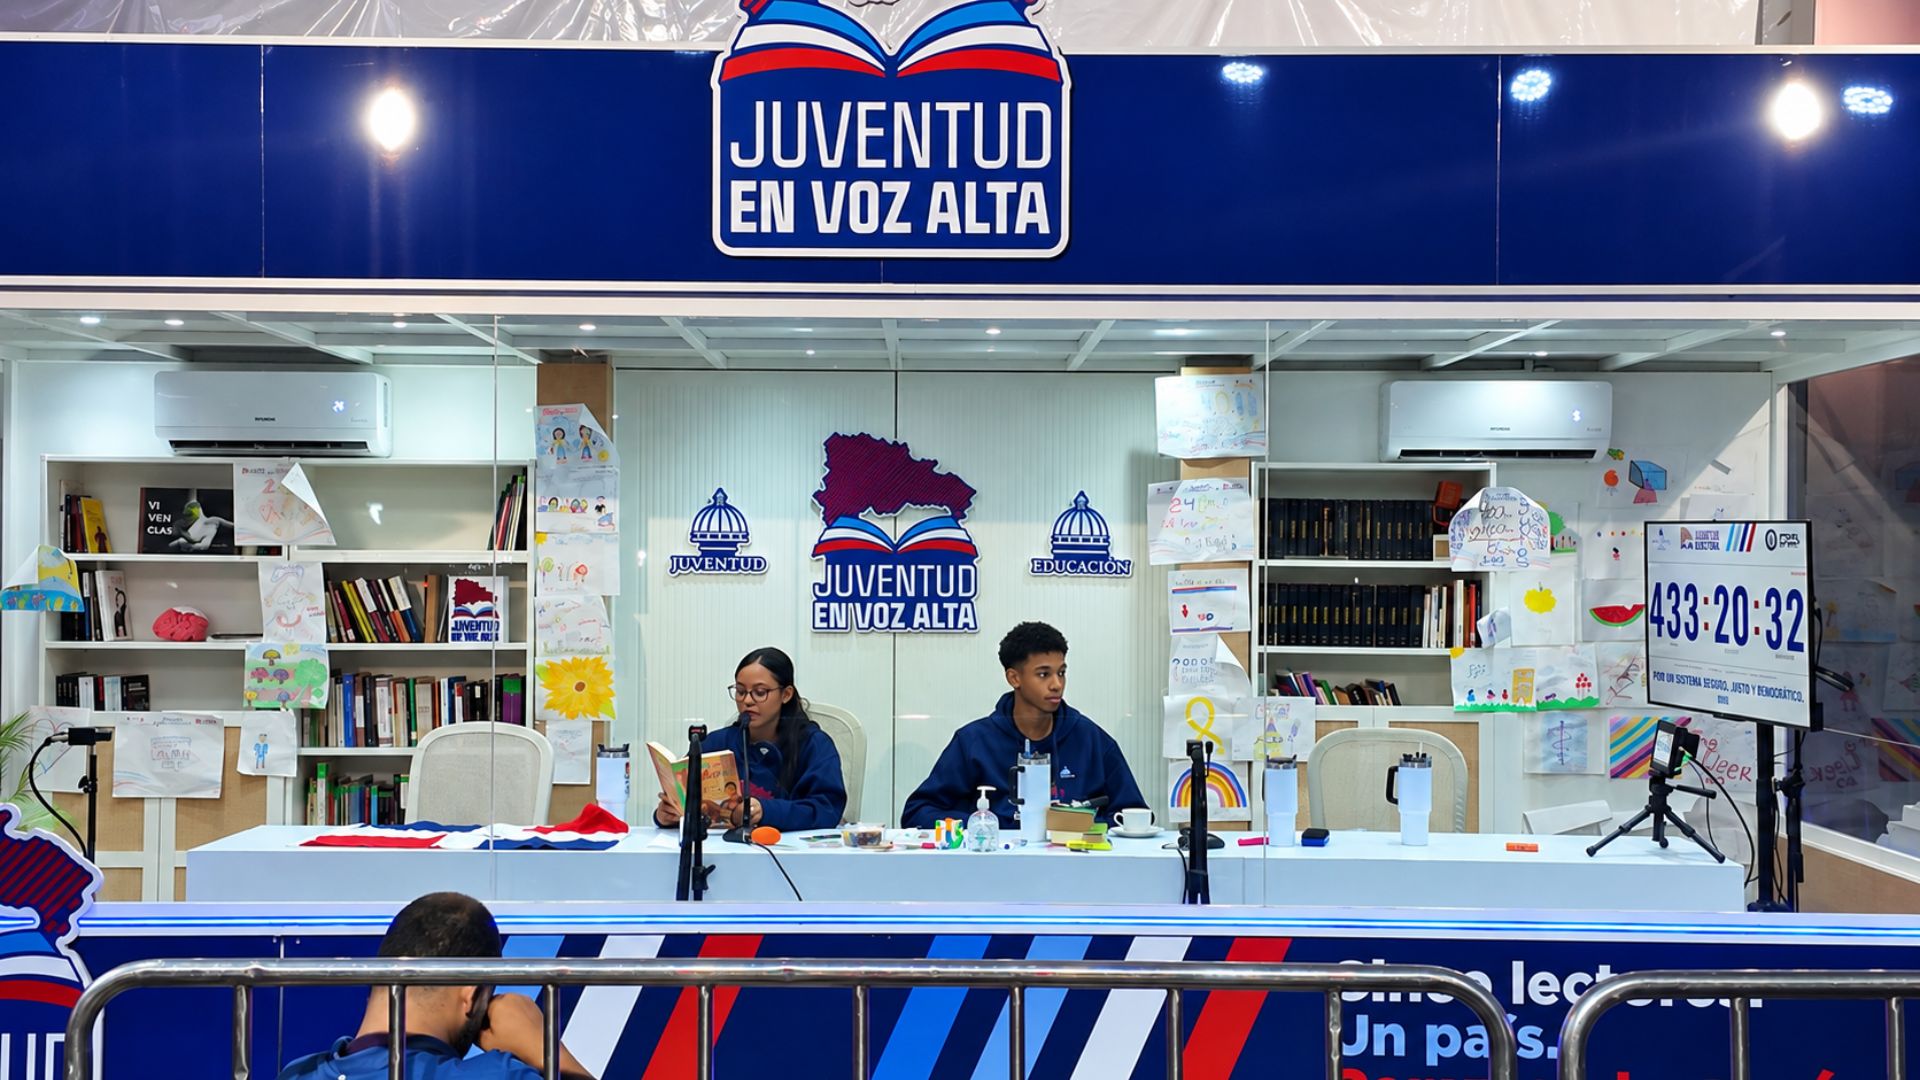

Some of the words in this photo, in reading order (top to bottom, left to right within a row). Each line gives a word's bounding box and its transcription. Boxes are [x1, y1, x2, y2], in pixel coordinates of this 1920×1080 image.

[729, 100, 1053, 169] JUVENTUD
[730, 179, 795, 234] EN
[810, 179, 912, 235] VOZ
[926, 180, 1051, 235] ALTA
[148, 500, 161, 511] VI
[148, 513, 172, 523] VEN
[671, 556, 766, 573] JUVENTUD
[814, 564, 976, 598] JUVENTUD
[1032, 556, 1131, 574] EDUCACIÓN
[814, 602, 847, 628] EN
[854, 602, 906, 629] VOZ
[912, 602, 976, 629] ALTA
[1650, 581, 1805, 653] 433:20:32
[1342, 1014, 1406, 1057] Un
[1425, 1013, 1558, 1067] pas.
